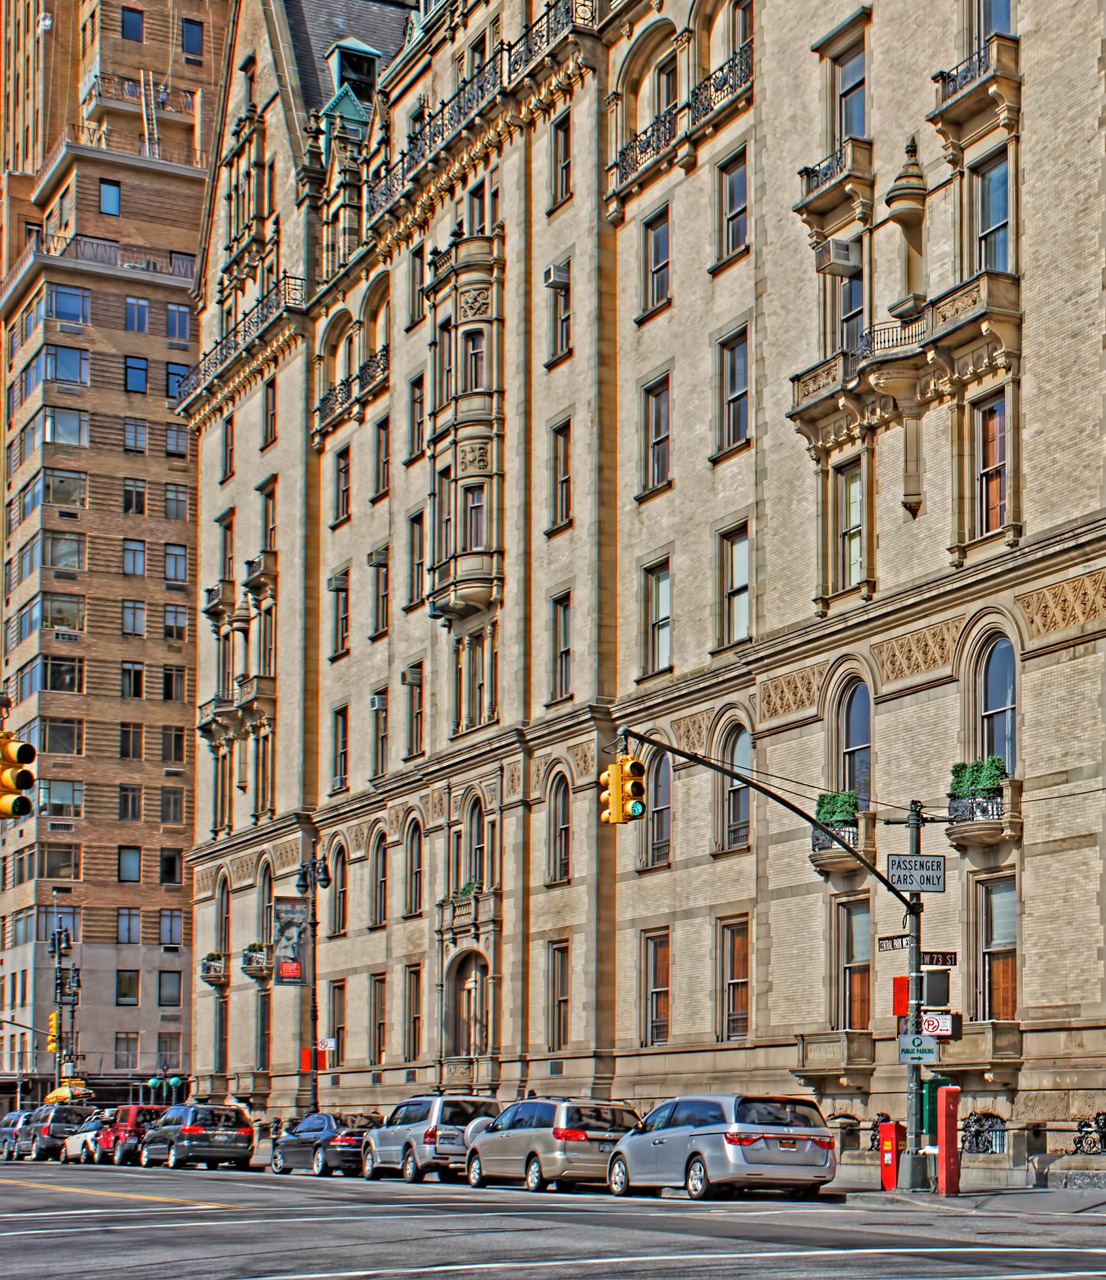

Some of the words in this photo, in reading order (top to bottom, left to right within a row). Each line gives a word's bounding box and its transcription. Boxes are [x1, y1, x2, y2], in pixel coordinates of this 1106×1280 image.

[891, 860, 942, 871] PASSENGER
[891, 874, 914, 885] CARS
[920, 874, 942, 885] ONLY
[893, 938, 902, 950] PARK
[902, 937, 910, 949] WES
[923, 954, 931, 965] W
[932, 954, 942, 965] 73
[946, 954, 956, 965] ST
